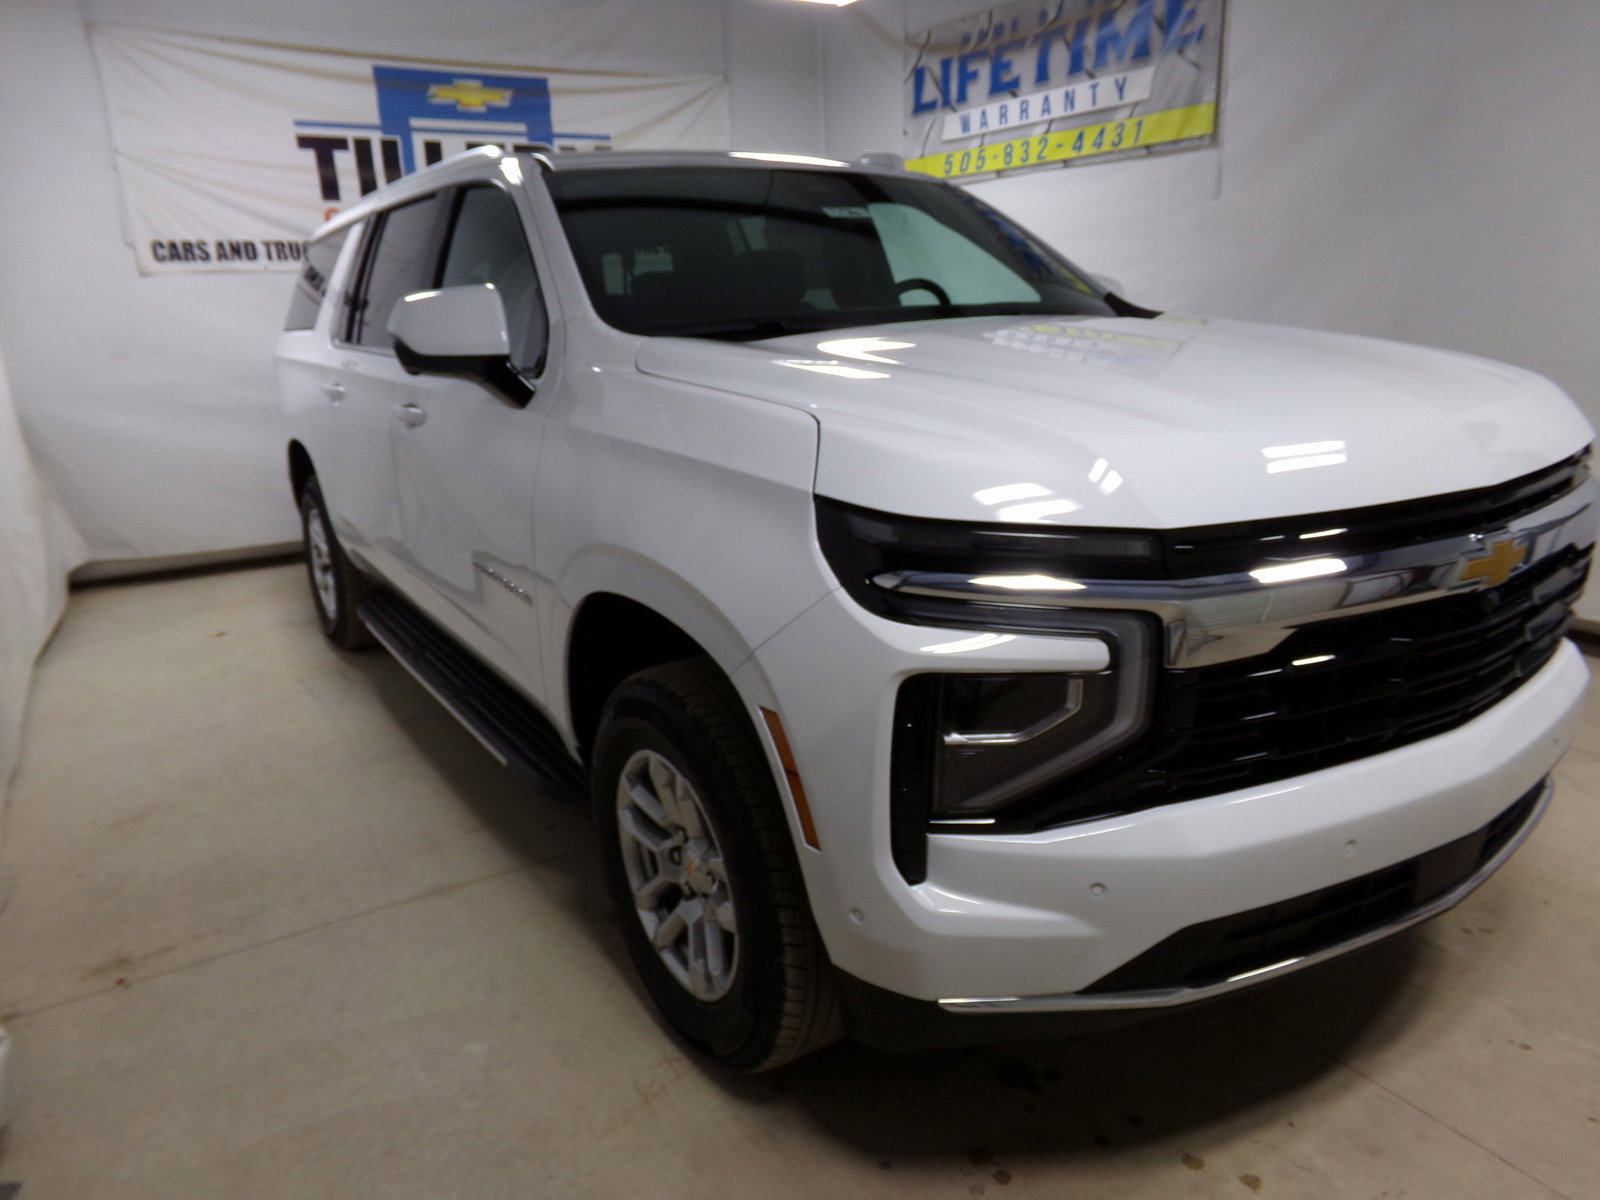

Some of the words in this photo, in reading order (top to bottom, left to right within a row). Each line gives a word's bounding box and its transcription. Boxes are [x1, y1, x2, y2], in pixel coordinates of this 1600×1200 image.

[911, 0, 1205, 115] LIFETIME
[960, 76, 1128, 135] WARRANTY
[943, 119, 1145, 176] 505-832-4431
[152, 240, 211, 262] CARS
[214, 240, 258, 261] AND
